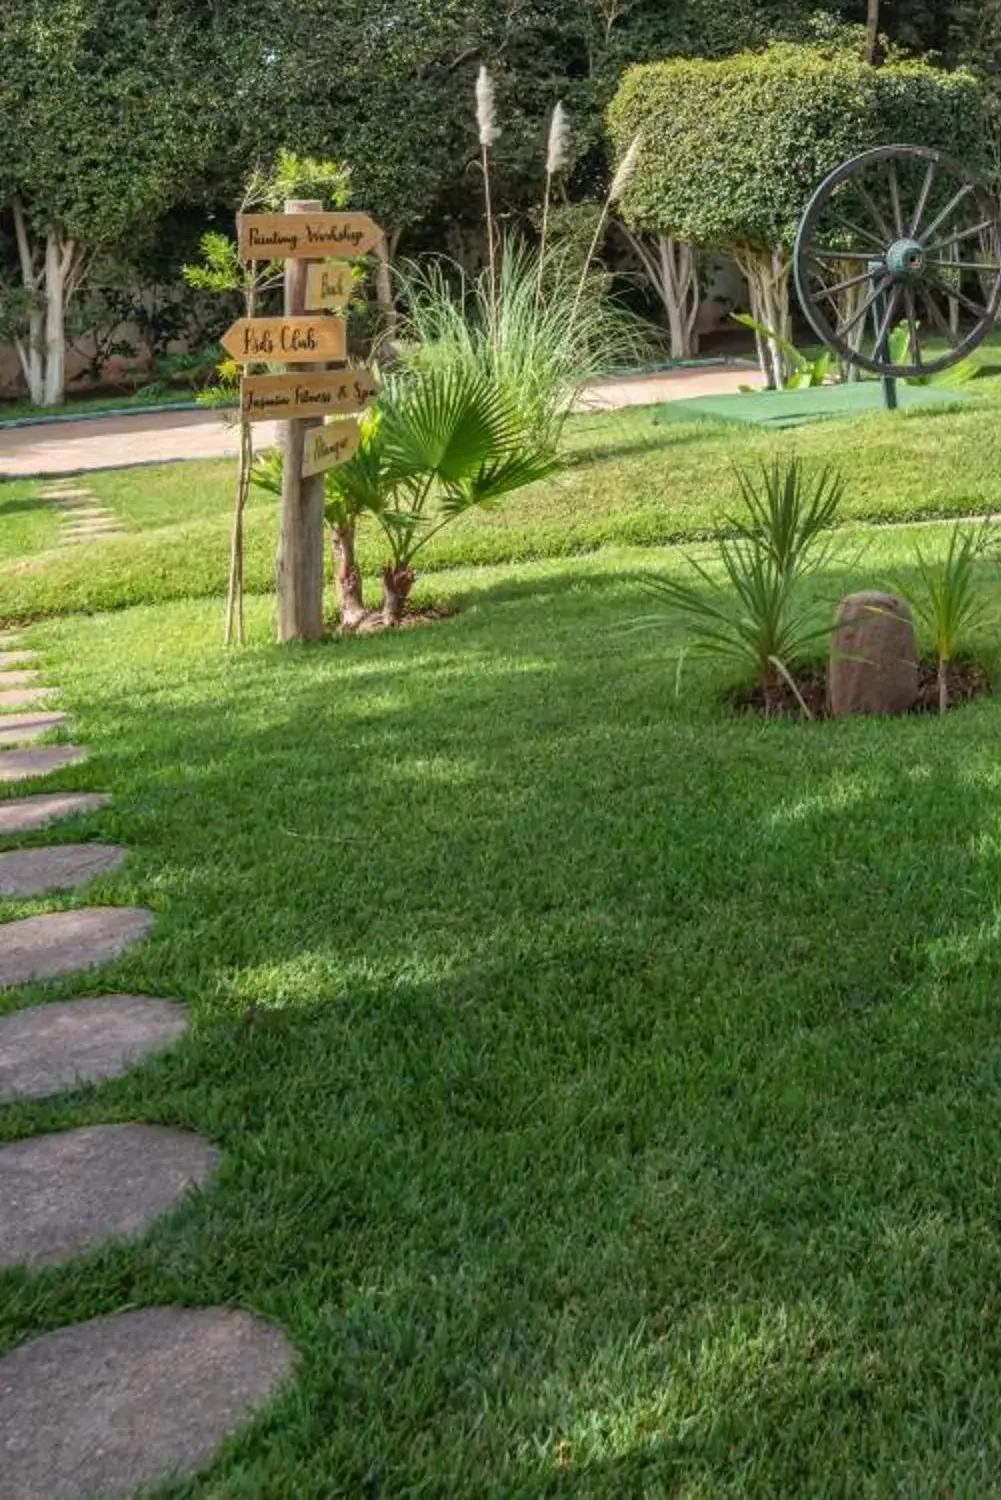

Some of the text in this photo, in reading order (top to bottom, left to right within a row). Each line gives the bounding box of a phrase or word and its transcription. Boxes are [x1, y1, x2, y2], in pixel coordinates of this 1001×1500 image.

[249, 222, 363, 250] Painting Workshop
[243, 324, 318, 355] Kids Club
[295, 383, 331, 404] Fitness
[338, 385, 347, 399] &
[354, 381, 378, 406] Spa
